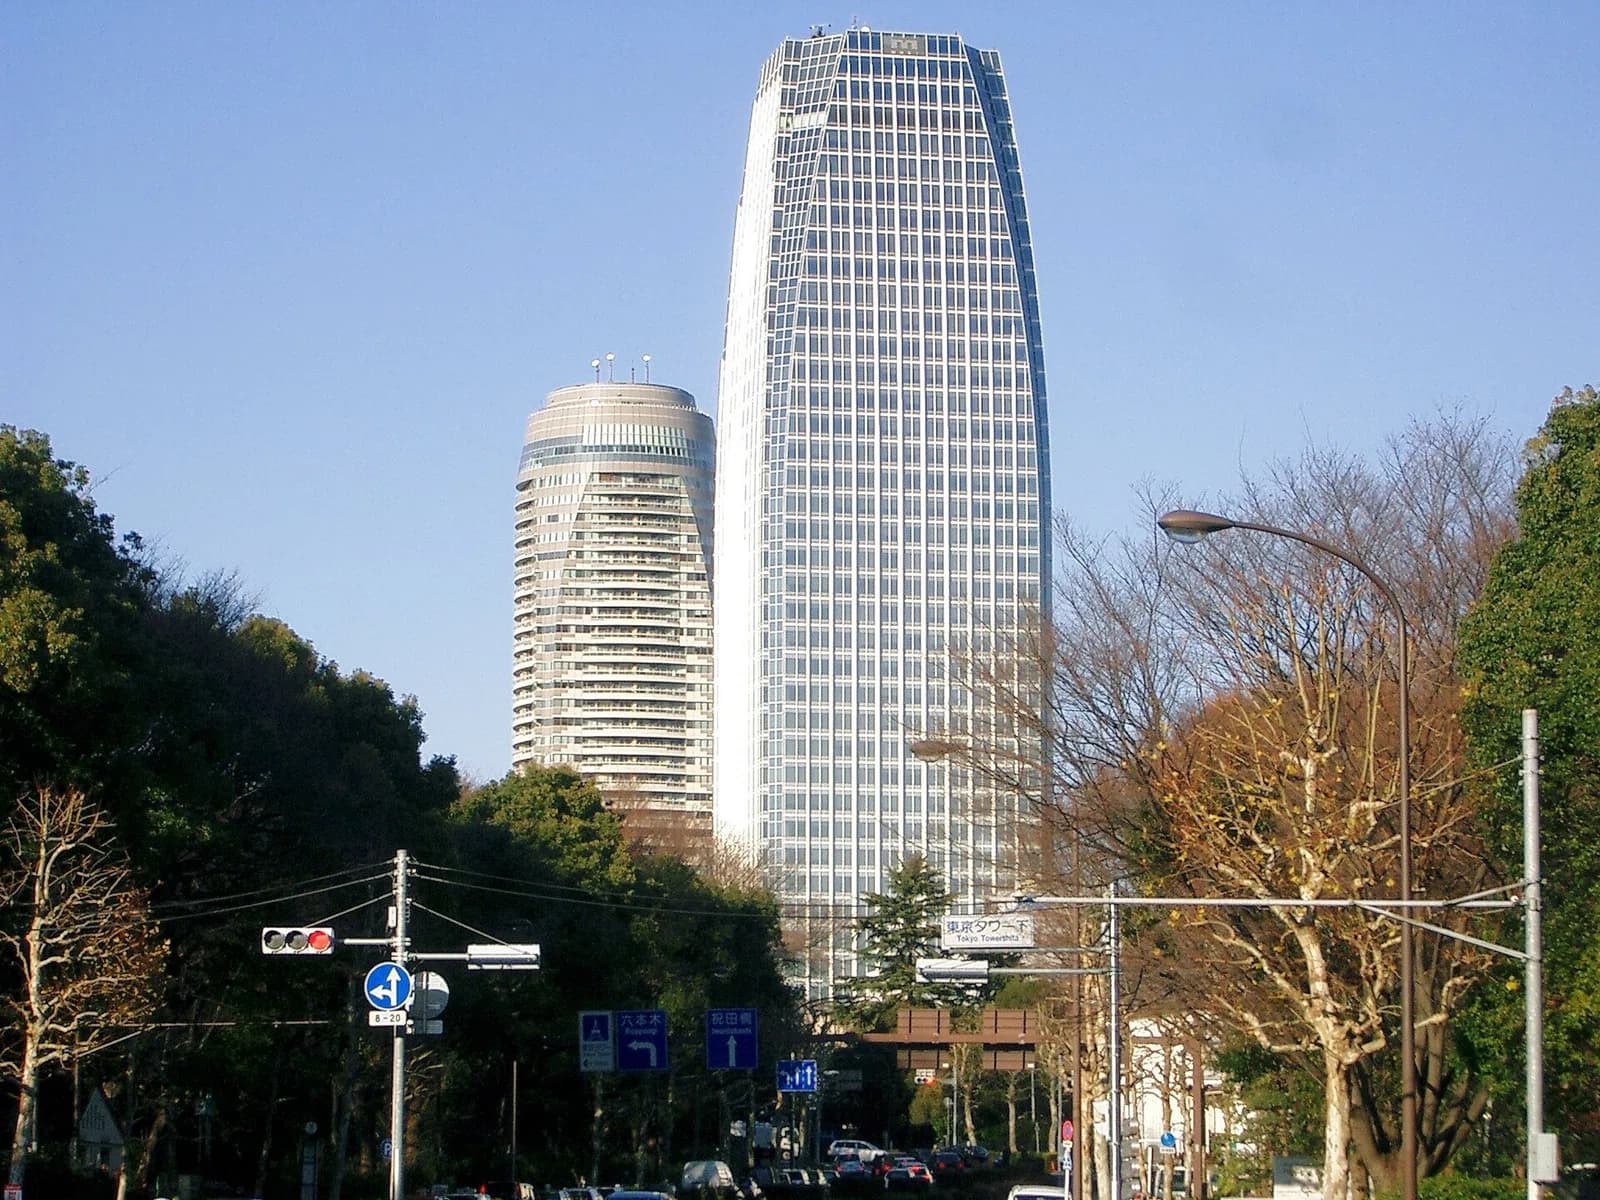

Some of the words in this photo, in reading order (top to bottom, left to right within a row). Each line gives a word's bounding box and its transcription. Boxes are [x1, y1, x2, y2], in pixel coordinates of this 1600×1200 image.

[946, 919, 1029, 933] 東京タワー下
[957, 935, 978, 943] Tokyo
[981, 934, 1019, 942] Towershita
[620, 1013, 662, 1026] 六本木
